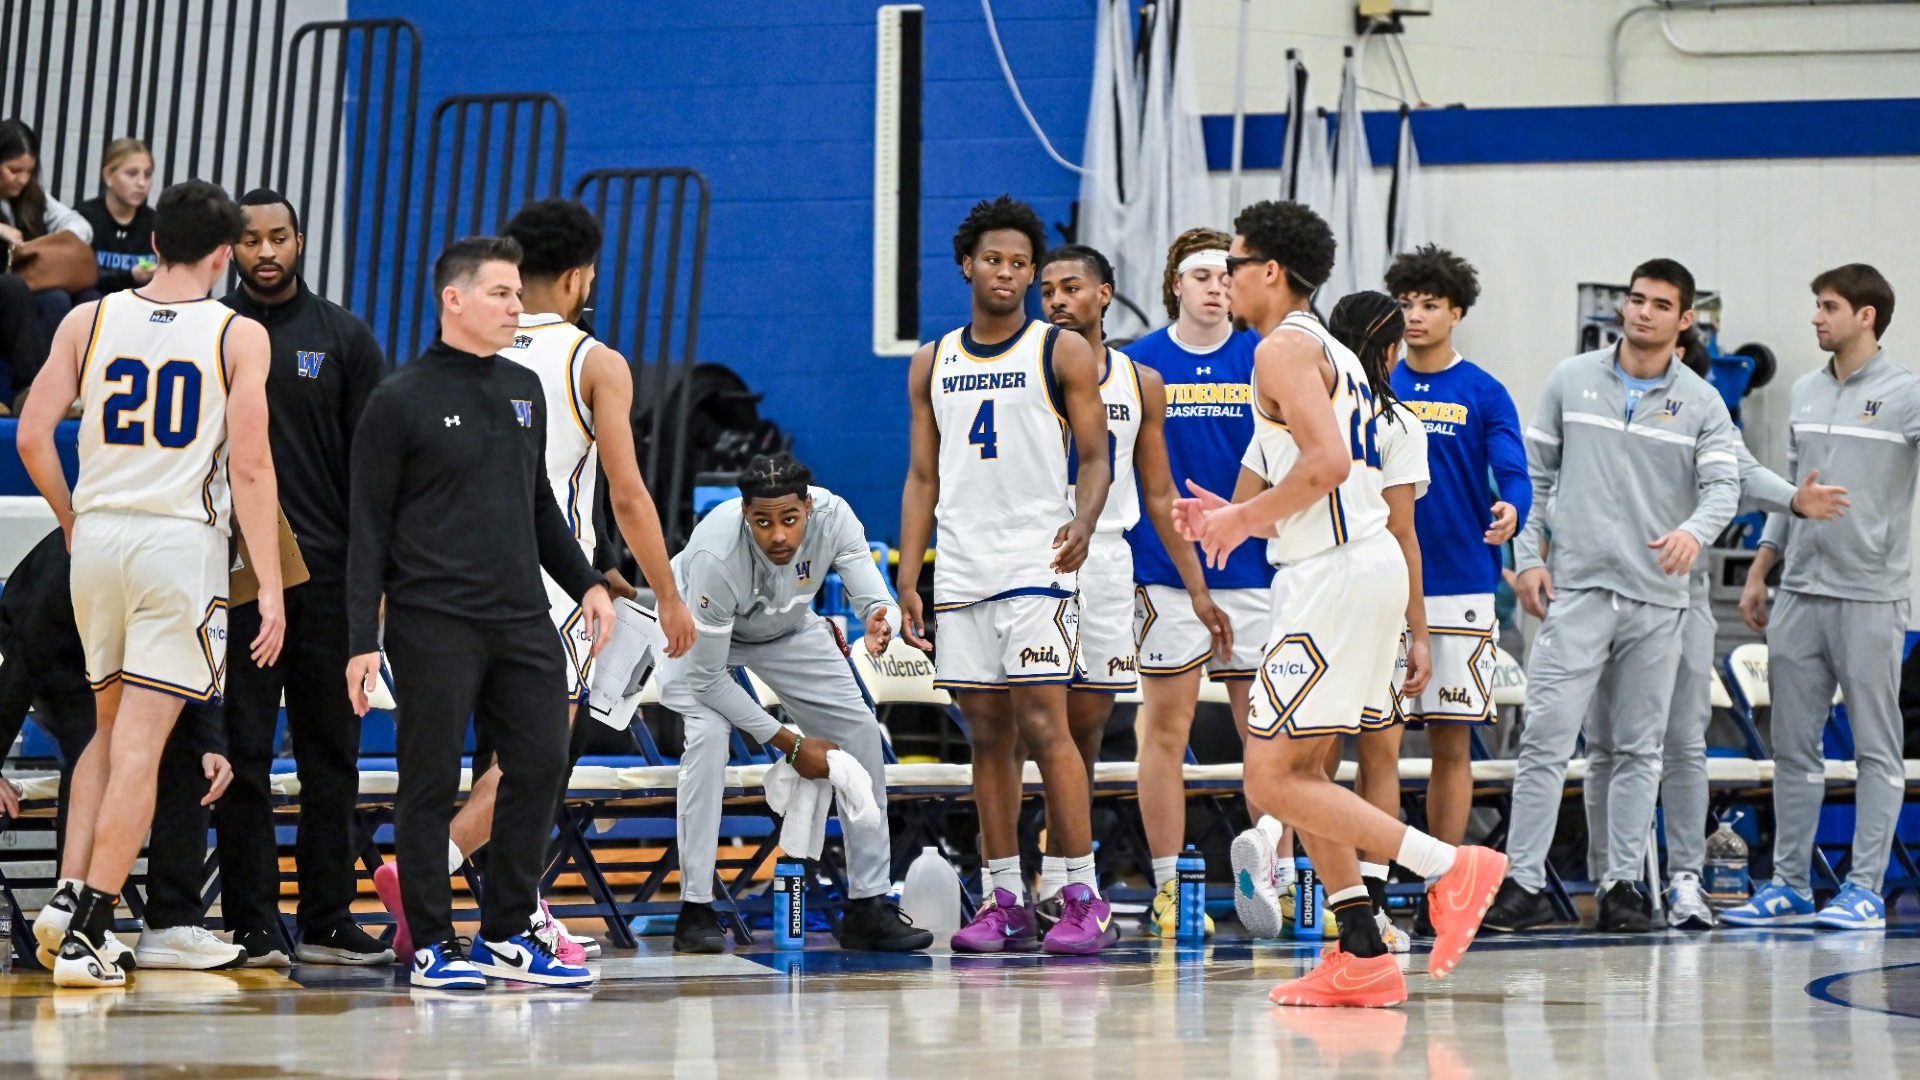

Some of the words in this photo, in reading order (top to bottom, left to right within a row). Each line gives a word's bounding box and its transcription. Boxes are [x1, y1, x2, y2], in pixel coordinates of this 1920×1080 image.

[297, 351, 326, 378] W
[942, 371, 1026, 394] WIDENER
[102, 356, 203, 449] 20
[1165, 405, 1244, 417] BASKETBALL
[968, 398, 998, 460] 4
[1345, 371, 1383, 472] 22
[864, 654, 932, 677] Widener
[1019, 645, 1061, 668] Pride
[1107, 656, 1136, 676] Prid
[1271, 661, 1308, 678] 21/CL
[1438, 686, 1473, 708] Pride
[792, 876, 801, 936] POWERADE
[1304, 869, 1313, 926] POWERADE
